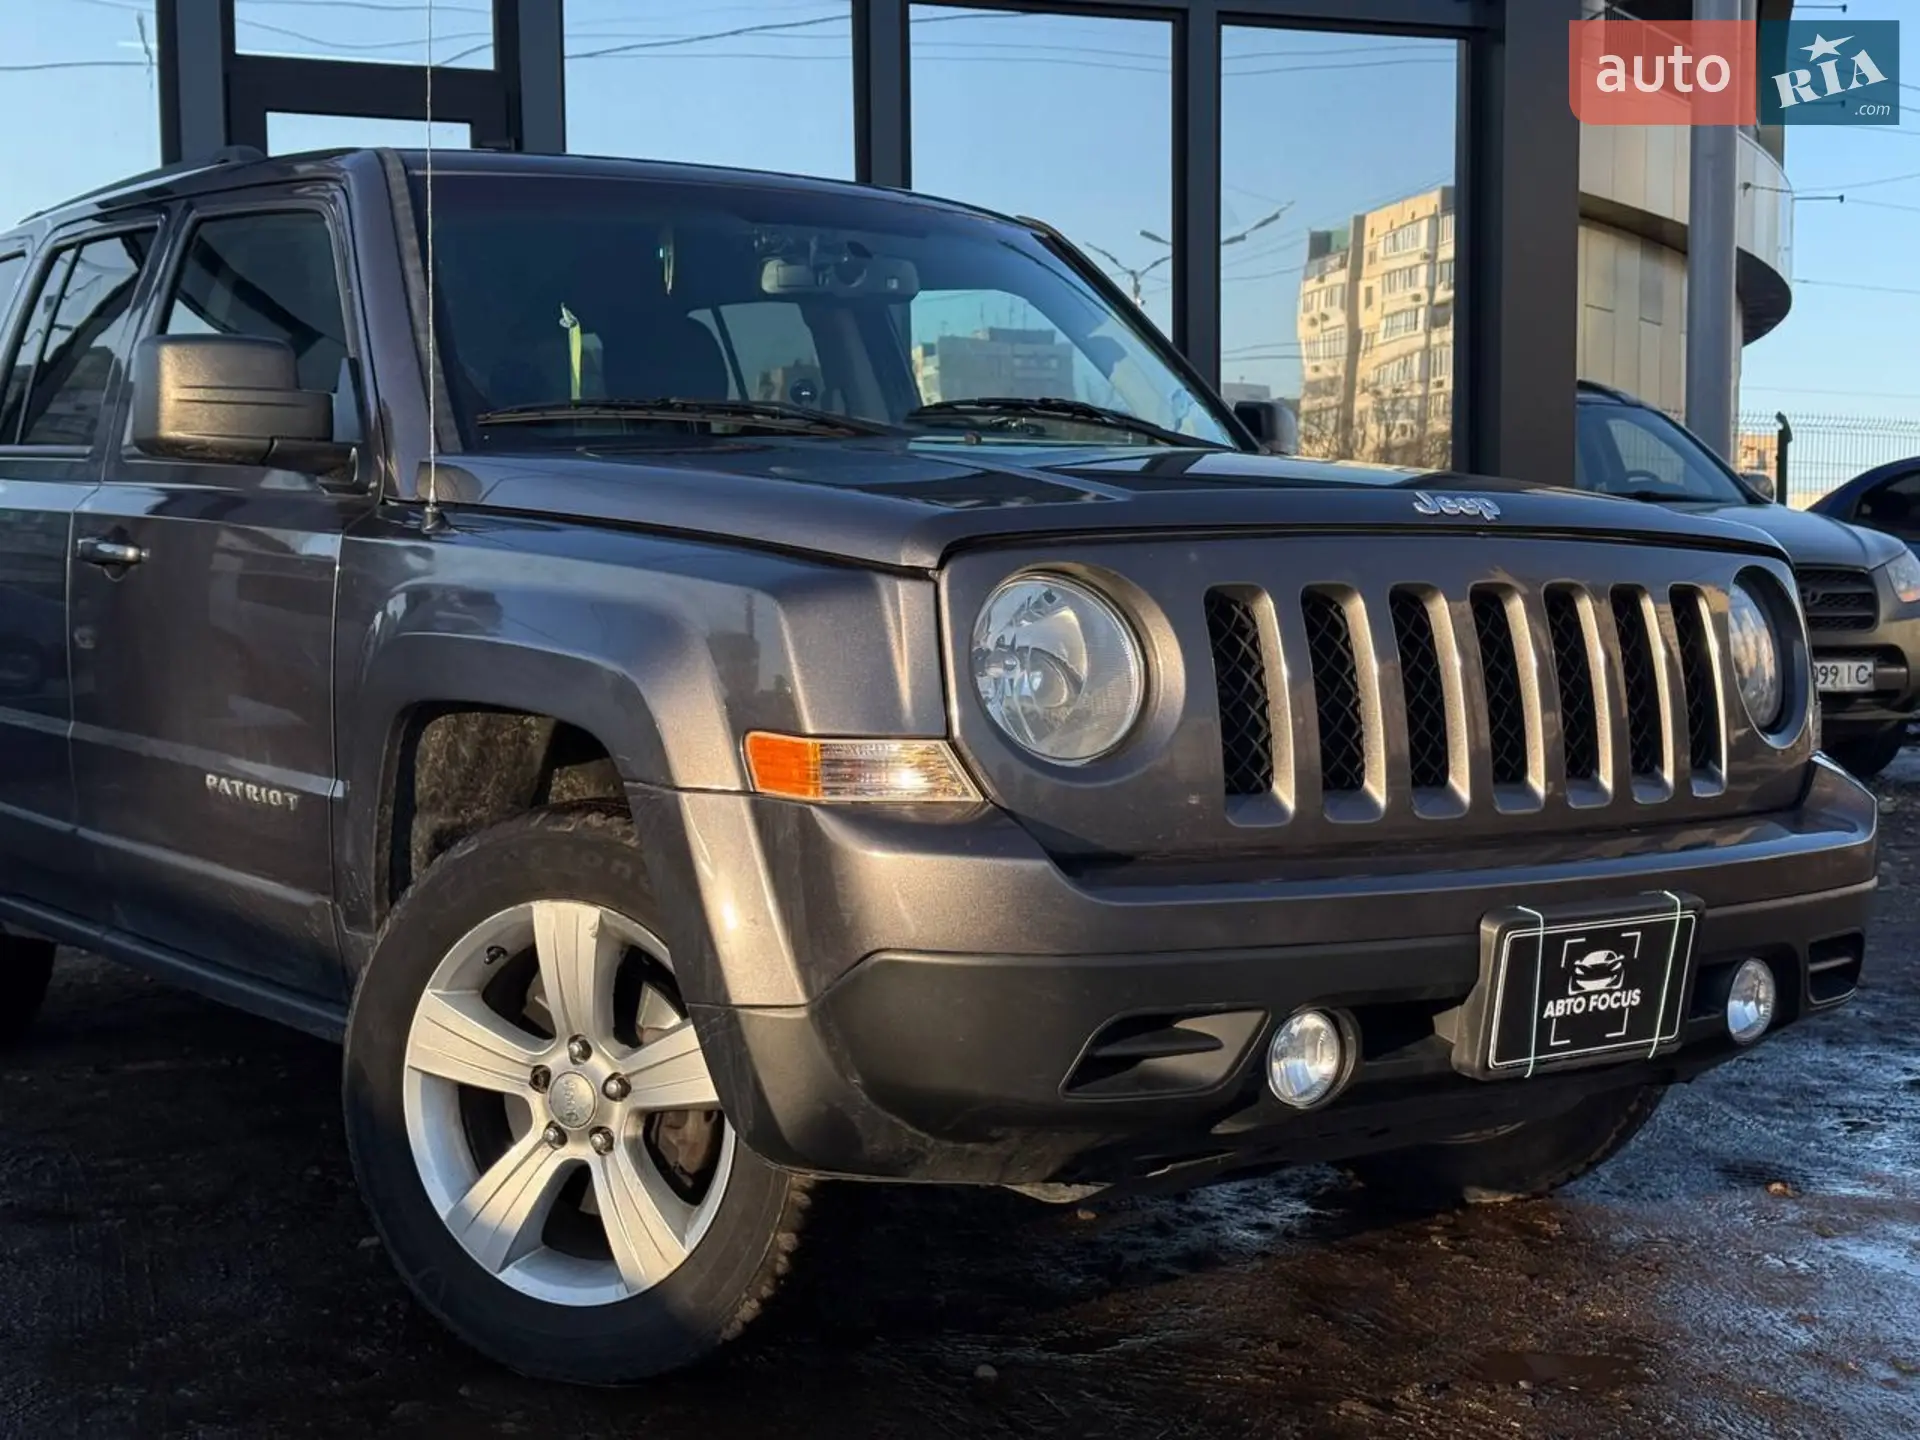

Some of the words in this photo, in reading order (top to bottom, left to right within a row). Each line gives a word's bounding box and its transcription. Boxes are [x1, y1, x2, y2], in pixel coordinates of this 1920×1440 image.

[1412, 490, 1501, 521] Jeep
[205, 773, 299, 811] PATRIOT
[1588, 988, 1642, 1012] FOCUS
